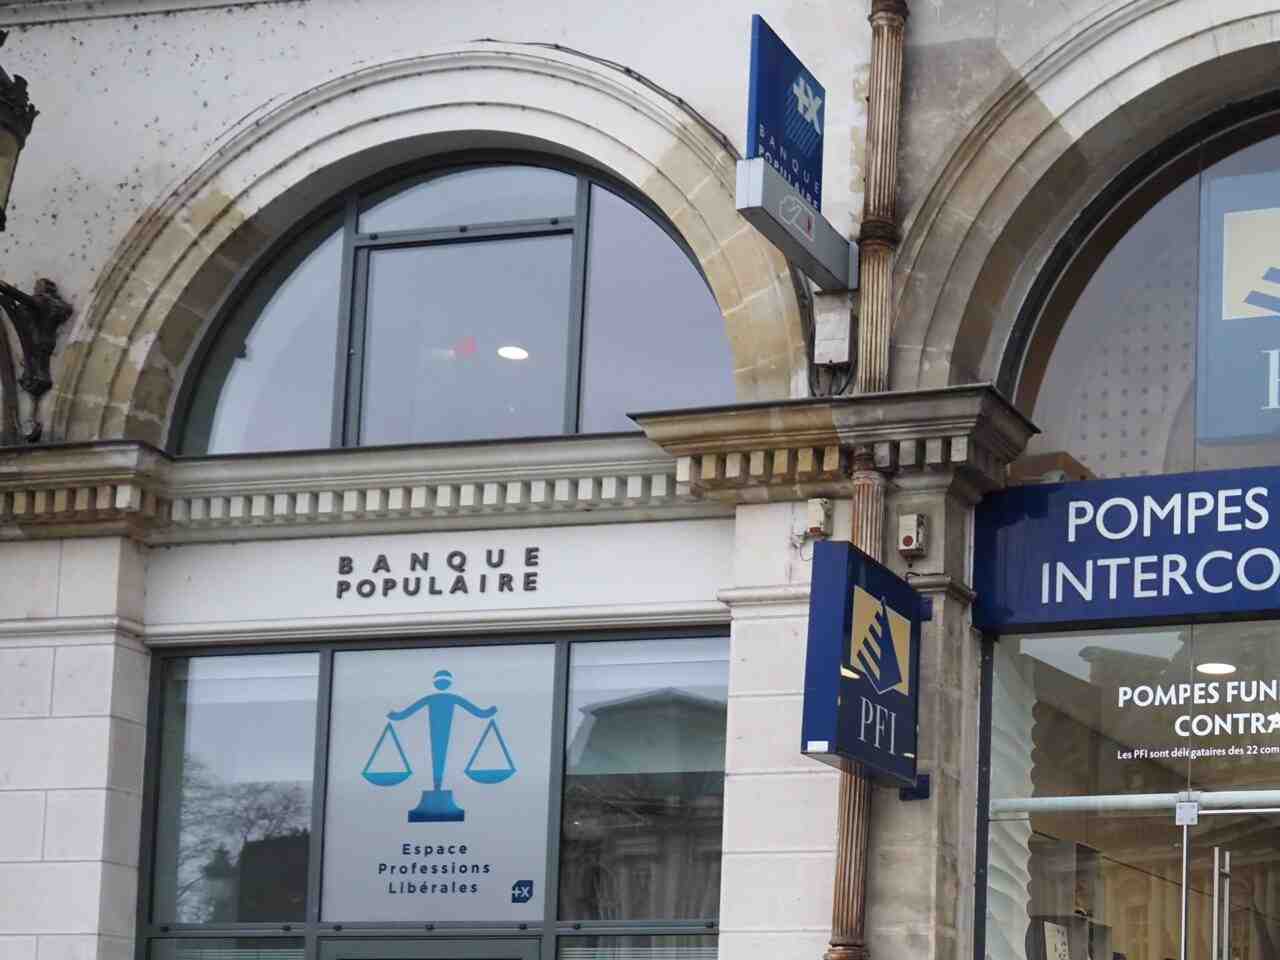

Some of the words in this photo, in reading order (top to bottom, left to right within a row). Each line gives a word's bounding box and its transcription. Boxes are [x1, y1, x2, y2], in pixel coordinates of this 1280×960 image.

[759, 124, 820, 194] BANQUE
[1066, 486, 1270, 542] POMPES
[338, 547, 540, 575] BANQUE
[336, 572, 539, 599] POPULAIRE
[1117, 682, 1220, 708] POMPES
[857, 695, 897, 755] PFI
[1117, 750, 1132, 760] Les
[1133, 749, 1147, 760] PFI
[1150, 749, 1170, 759] sont
[1228, 746, 1245, 756] des
[1246, 745, 1258, 755] 22
[401, 843, 468, 857] Espace
[378, 862, 491, 875] Professions
[388, 881, 479, 894] Libérales
